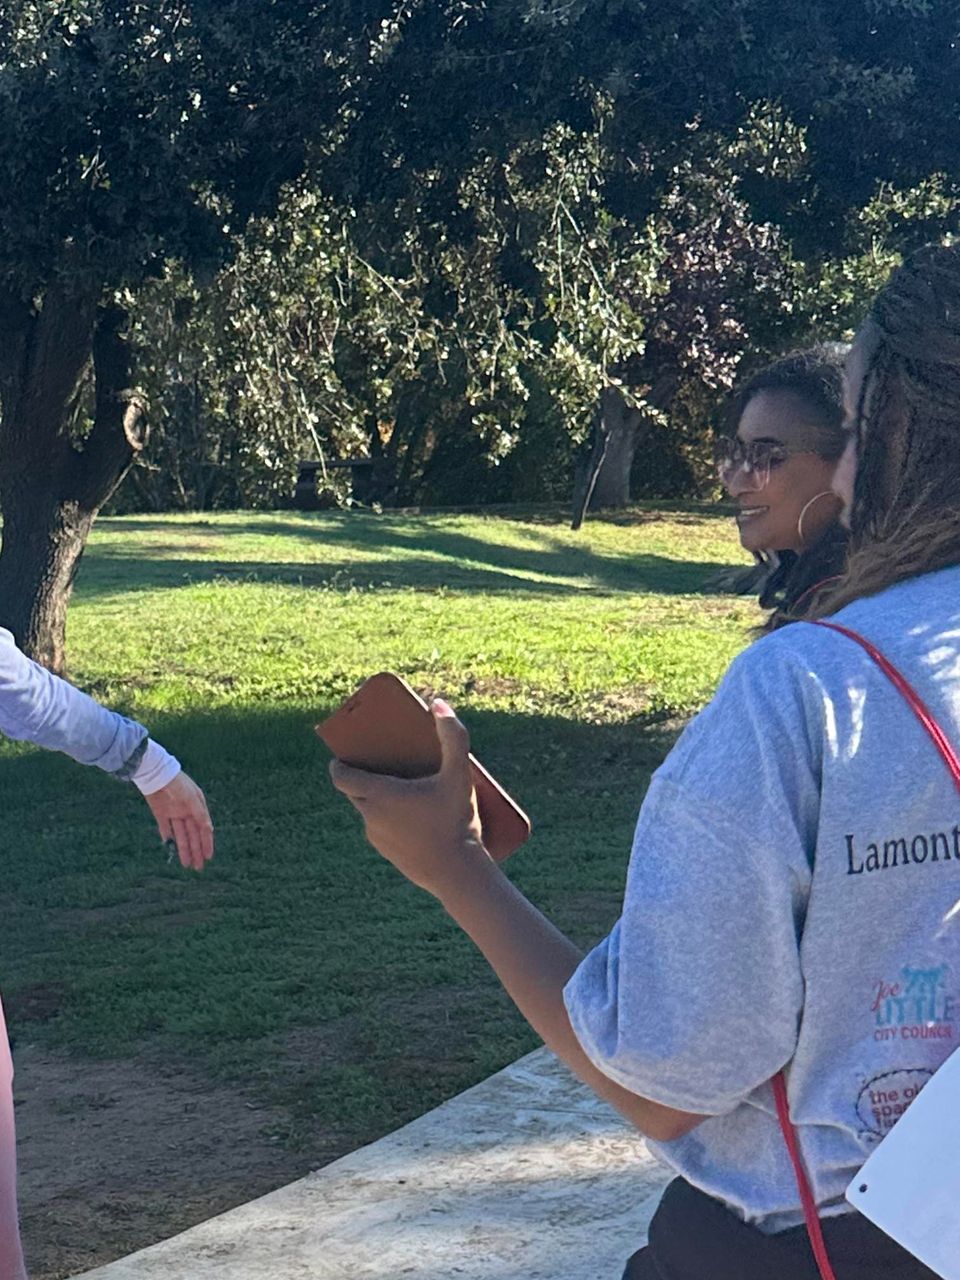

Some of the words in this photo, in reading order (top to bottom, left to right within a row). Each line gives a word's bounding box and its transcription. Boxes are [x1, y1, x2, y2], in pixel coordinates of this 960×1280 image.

[845, 825, 960, 875] Lamont
[871, 980, 899, 1012] Joe
[869, 1090, 898, 1104] the
